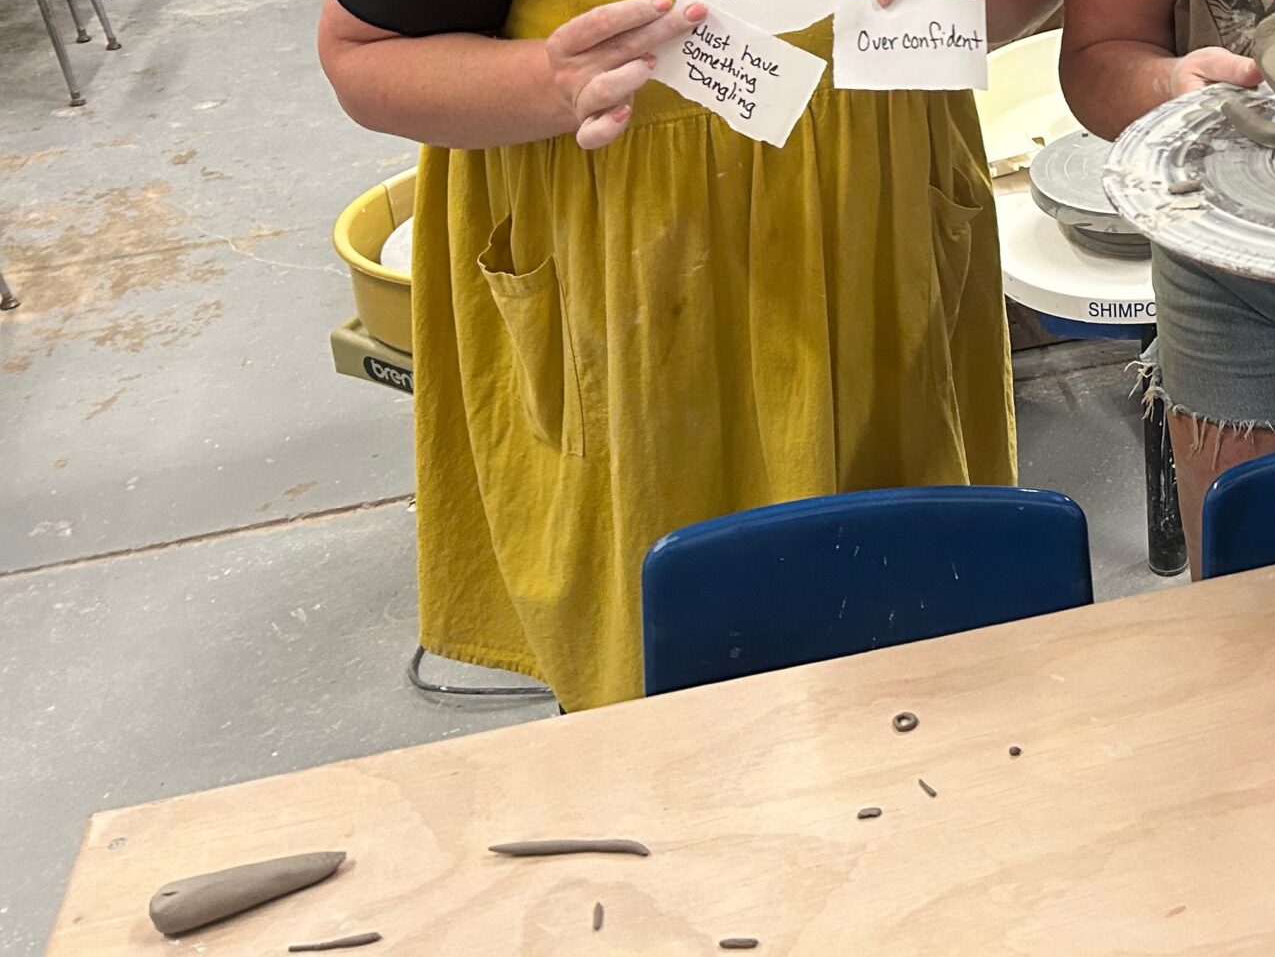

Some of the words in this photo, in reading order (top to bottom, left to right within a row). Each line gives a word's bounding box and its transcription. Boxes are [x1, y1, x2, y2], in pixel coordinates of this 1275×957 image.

[682, 40, 758, 94] something
[691, 24, 731, 52] Must
[740, 44, 780, 78] have
[687, 61, 756, 120] Dangling
[1088, 302, 1157, 318] SHIMPO
[370, 358, 413, 388] bren
